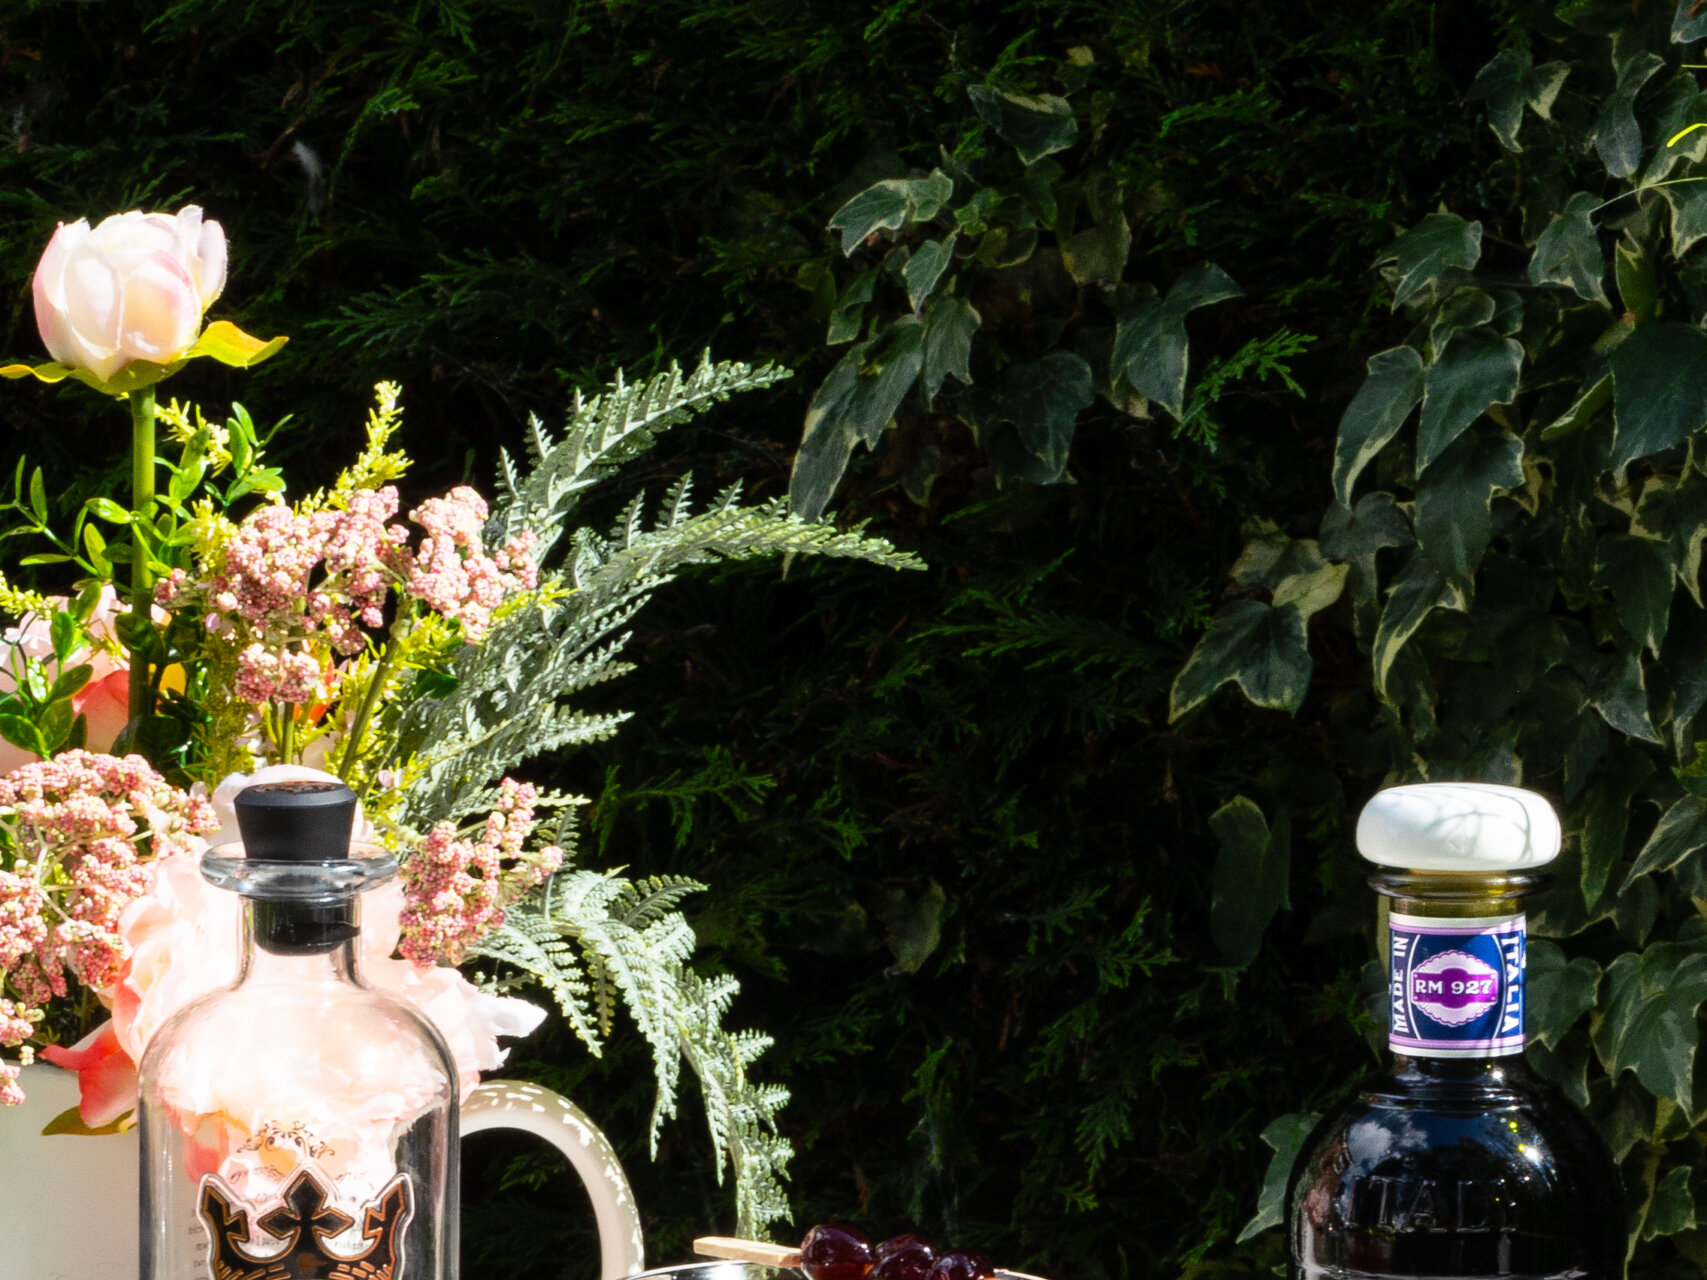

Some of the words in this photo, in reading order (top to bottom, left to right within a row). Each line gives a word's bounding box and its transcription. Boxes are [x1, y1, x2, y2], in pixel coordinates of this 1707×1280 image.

[1393, 936, 1409, 957] IN
[1393, 968, 1409, 1033] MADE
[1415, 979, 1443, 994] RM
[1451, 979, 1494, 995] 927
[1501, 936, 1520, 1033] ITALIA
